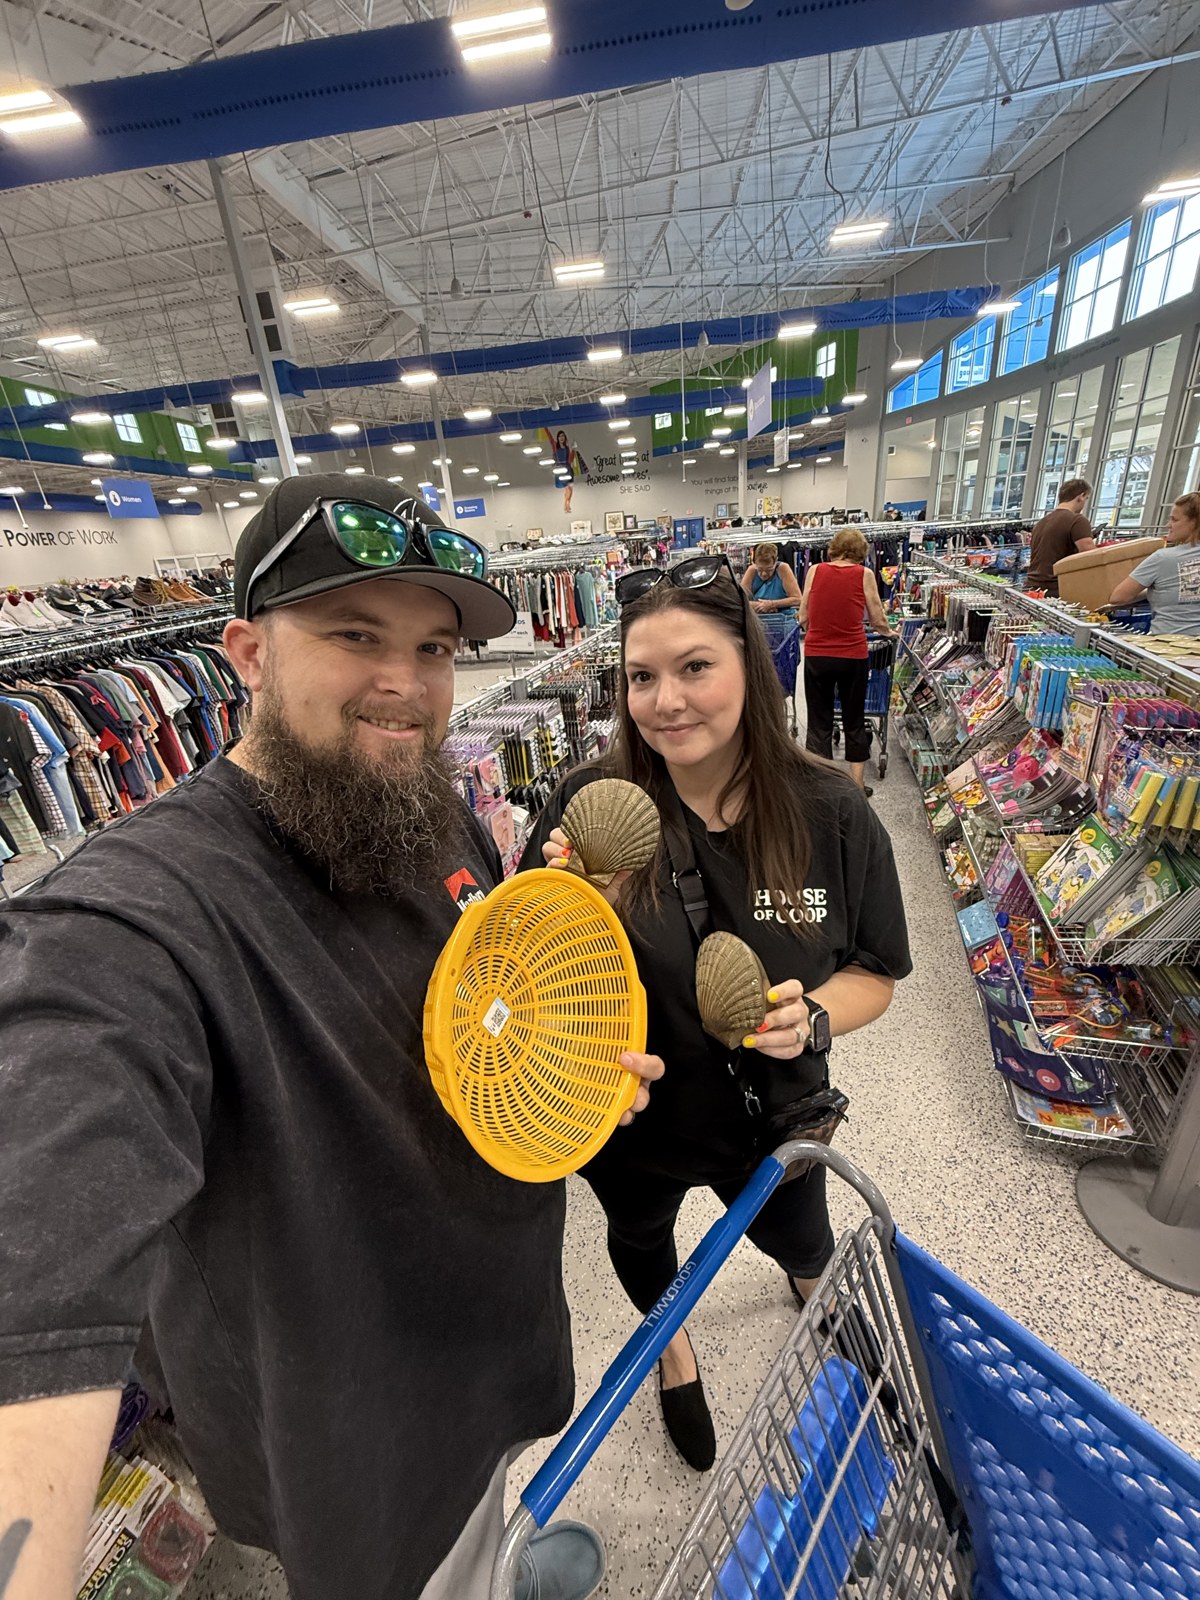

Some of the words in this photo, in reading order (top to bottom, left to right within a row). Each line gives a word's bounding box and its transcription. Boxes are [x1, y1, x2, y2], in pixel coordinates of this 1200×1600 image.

[641, 450, 650, 463] at
[586, 474, 620, 486] Awesome
[714, 476, 727, 484] find
[620, 486, 633, 494] SHE
[634, 485, 651, 493] SAID
[704, 487, 723, 495] things
[121, 495, 142, 503] Women
[58, 530, 76, 546] OF
[76, 529, 118, 546] WORK
[753, 909, 775, 921] OF
[775, 907, 828, 924] COOP
[641, 1261, 697, 1329] GOODWILL
[86, 1537, 133, 1600] CORDS
